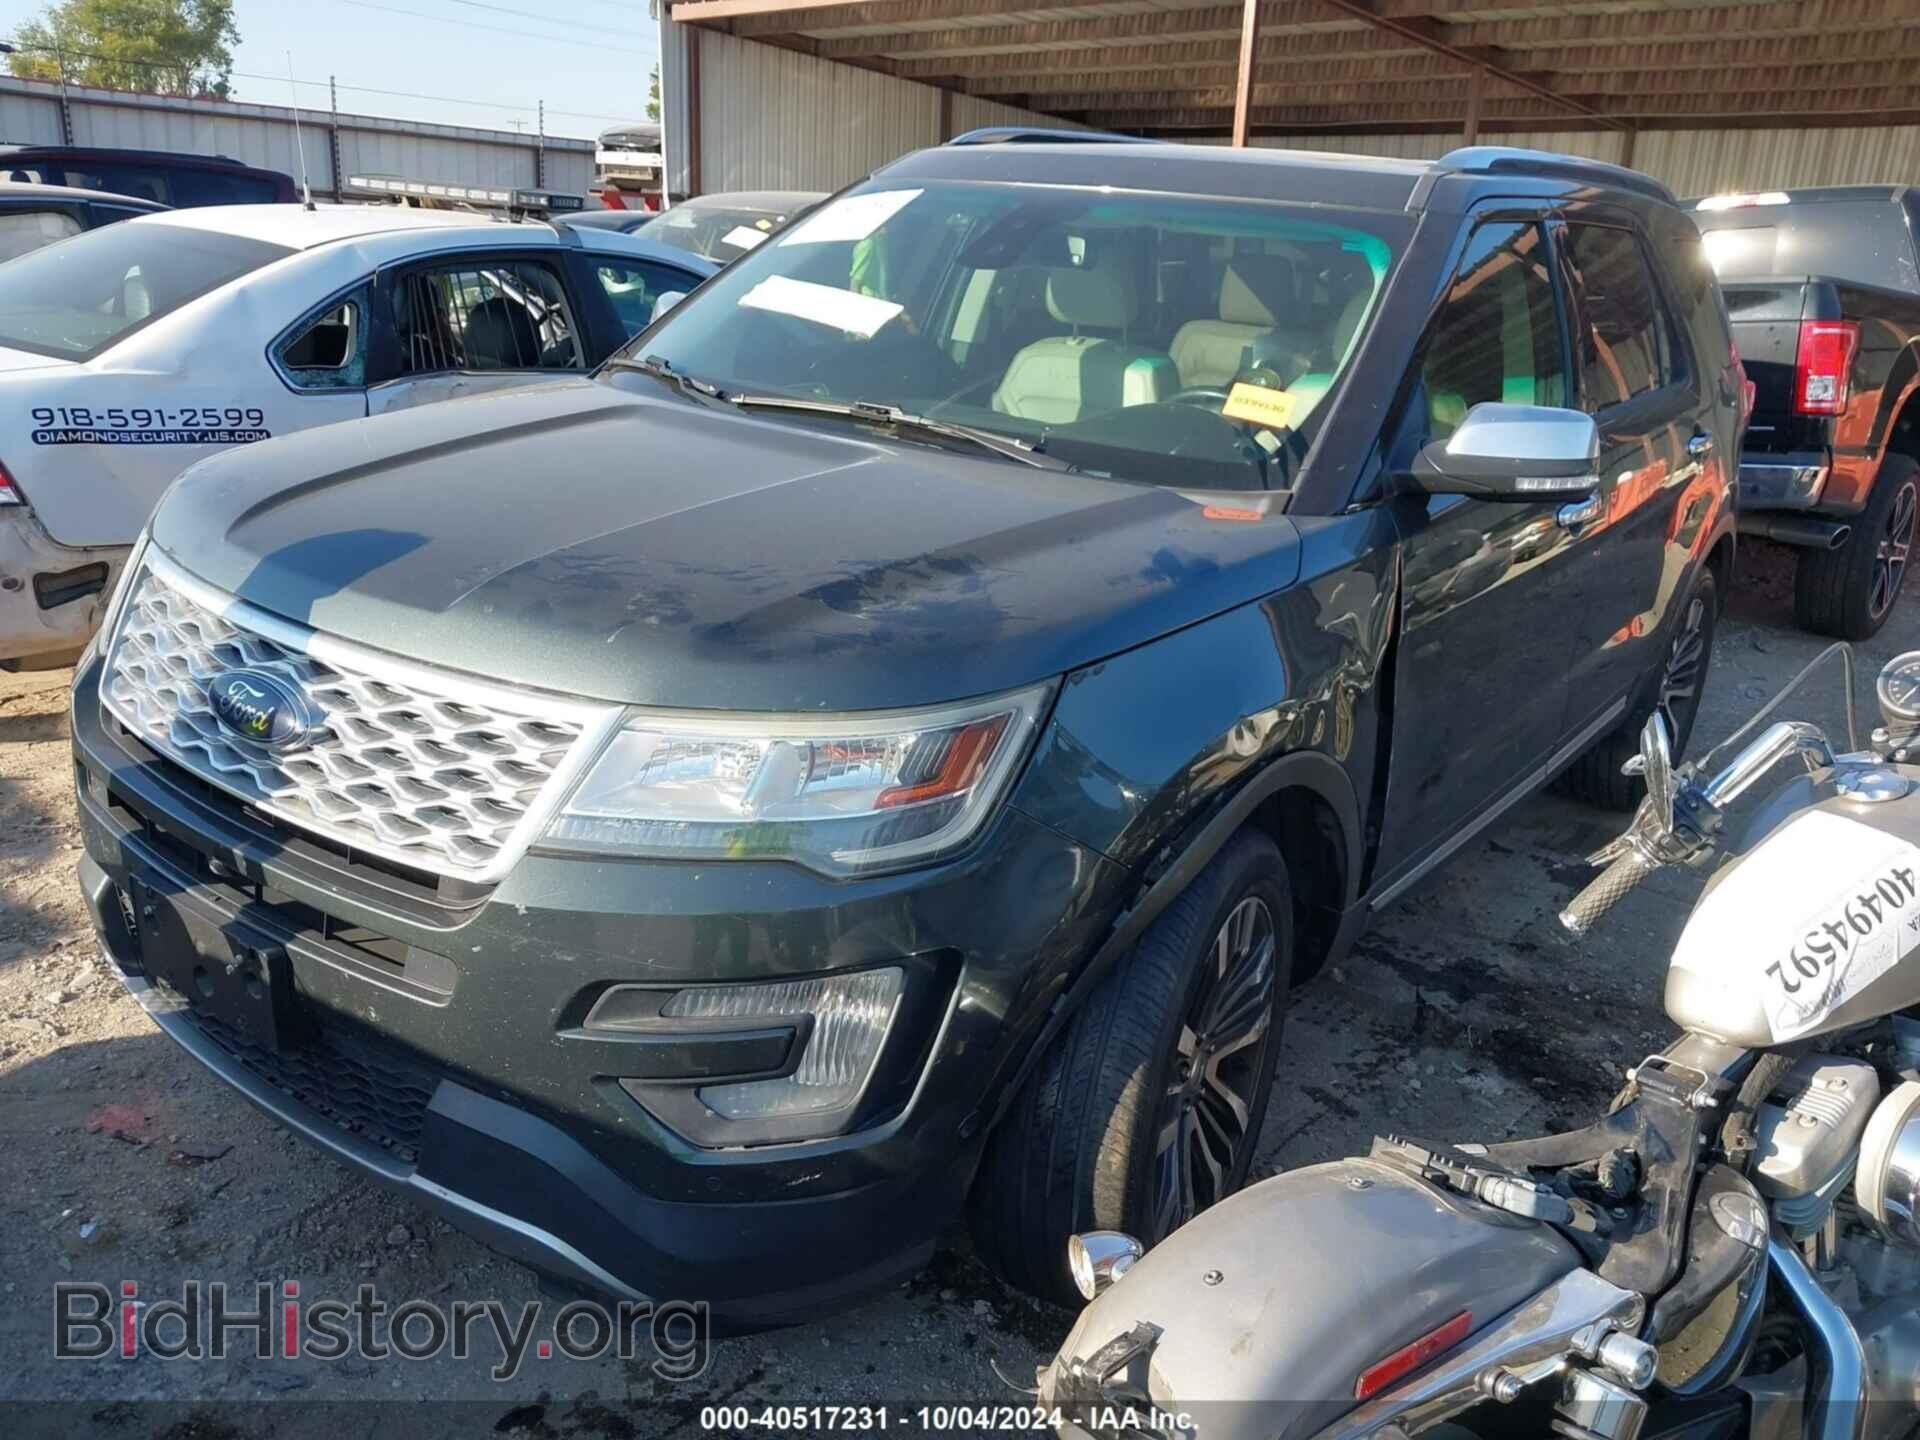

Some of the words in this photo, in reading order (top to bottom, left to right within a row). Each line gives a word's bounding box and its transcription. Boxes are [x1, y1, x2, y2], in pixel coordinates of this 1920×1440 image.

[31, 408, 264, 428] 918-591-2599
[36, 430, 268, 443] DIAMONDSECURITY.US.COM
[227, 680, 277, 731] Ford
[1765, 868, 1916, 994] 40494592
